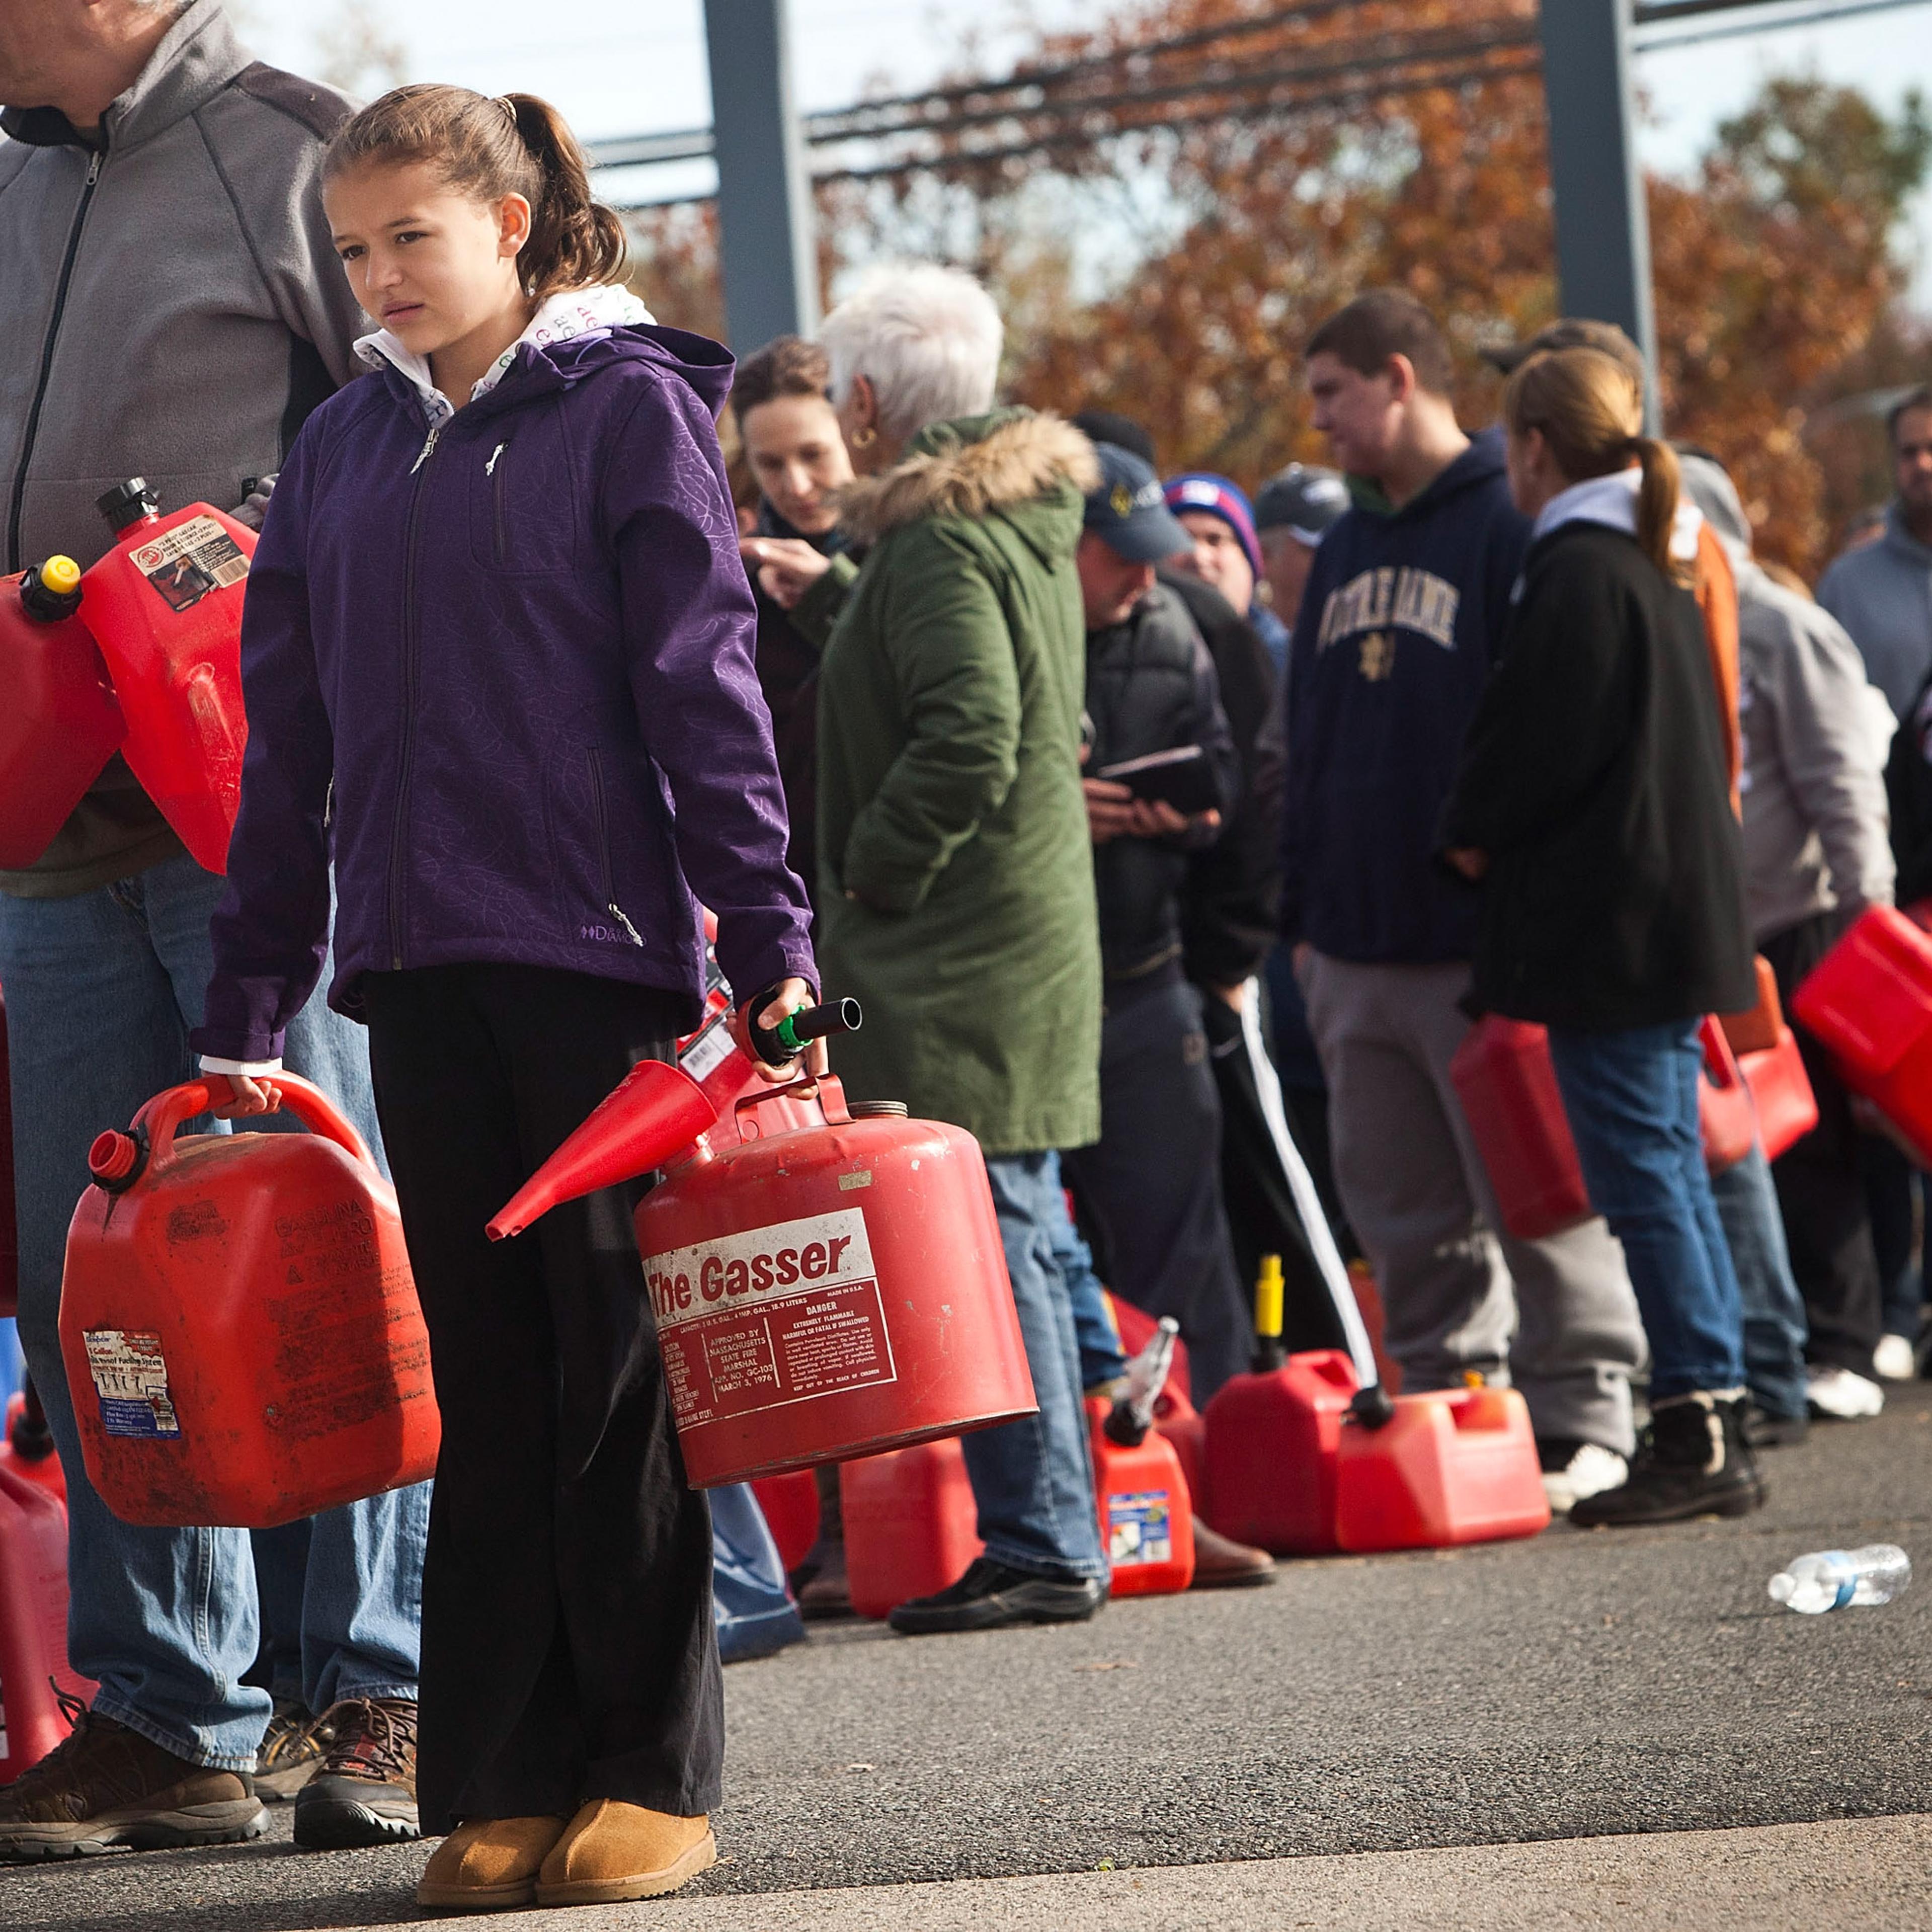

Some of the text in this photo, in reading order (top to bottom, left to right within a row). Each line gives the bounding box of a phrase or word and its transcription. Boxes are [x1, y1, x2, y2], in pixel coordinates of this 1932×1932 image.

[649, 1235, 851, 1318] The Gasser
[771, 1302, 784, 1310] 18.9
[786, 1298, 807, 1307] LITERS
[807, 1302, 837, 1315] DANGER
[782, 1330, 807, 1340] HARMFUL
[815, 1324, 832, 1332] FATAL
[838, 1316, 869, 1328] SWALLOWED
[793, 1311, 854, 1329] EXTREMELY FLAMMABLE
[710, 1337, 766, 1356] MASSACHUSETTS
[711, 1329, 758, 1346] APPROVED BY
[720, 1348, 757, 1363] STATE FIRE
[714, 1364, 773, 1383] APP. NO. GC-103
[724, 1358, 758, 1373] MARSHAL
[718, 1381, 741, 1392] MARCH
[754, 1374, 772, 1384] 1976
